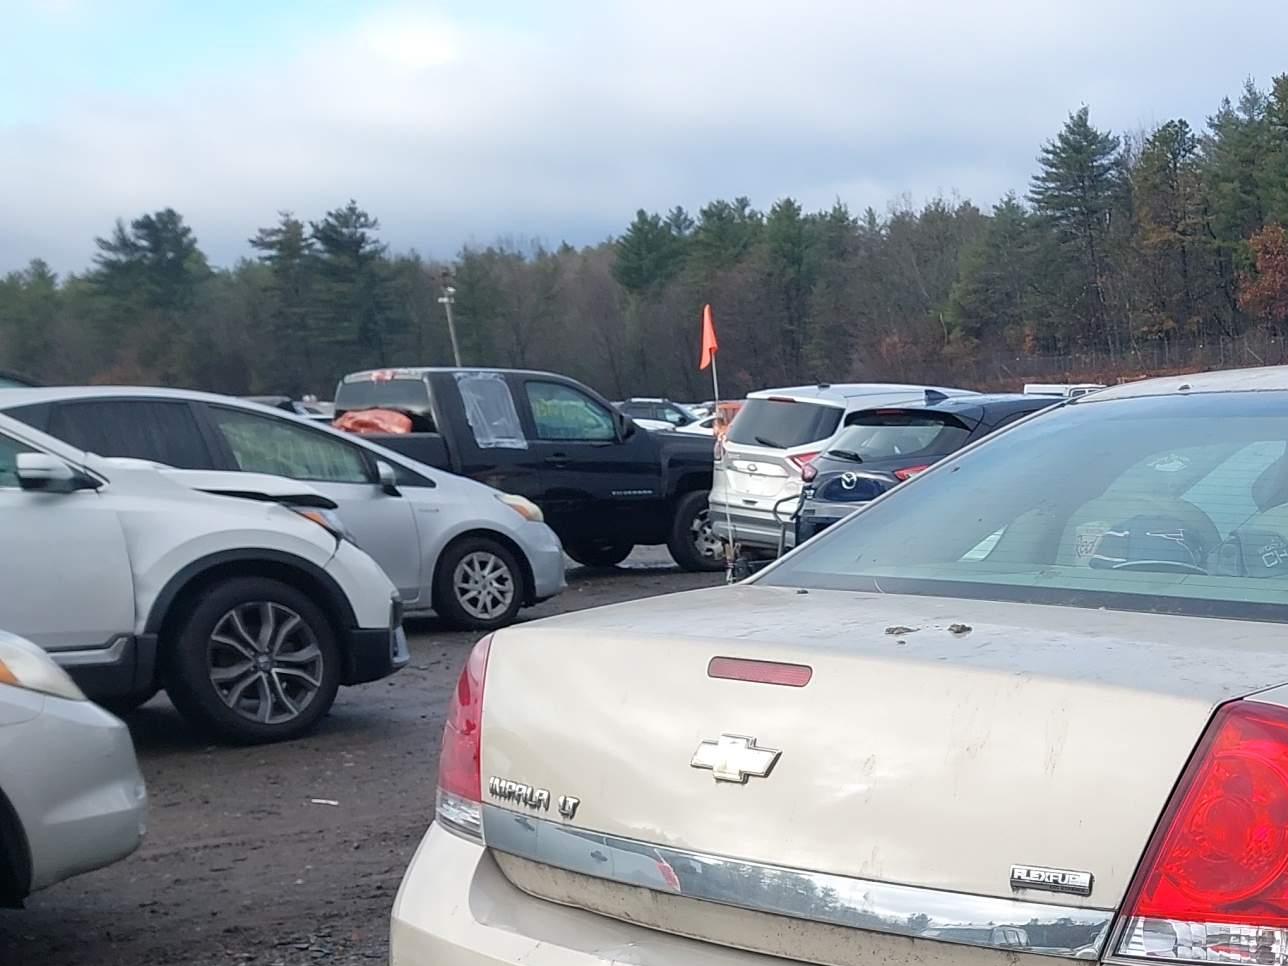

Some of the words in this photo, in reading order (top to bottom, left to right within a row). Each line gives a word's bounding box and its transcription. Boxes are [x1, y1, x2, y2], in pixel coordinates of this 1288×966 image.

[489, 776, 550, 811] IMPALA
[558, 796, 580, 820] LT
[1012, 867, 1089, 887] FLEXFUE
